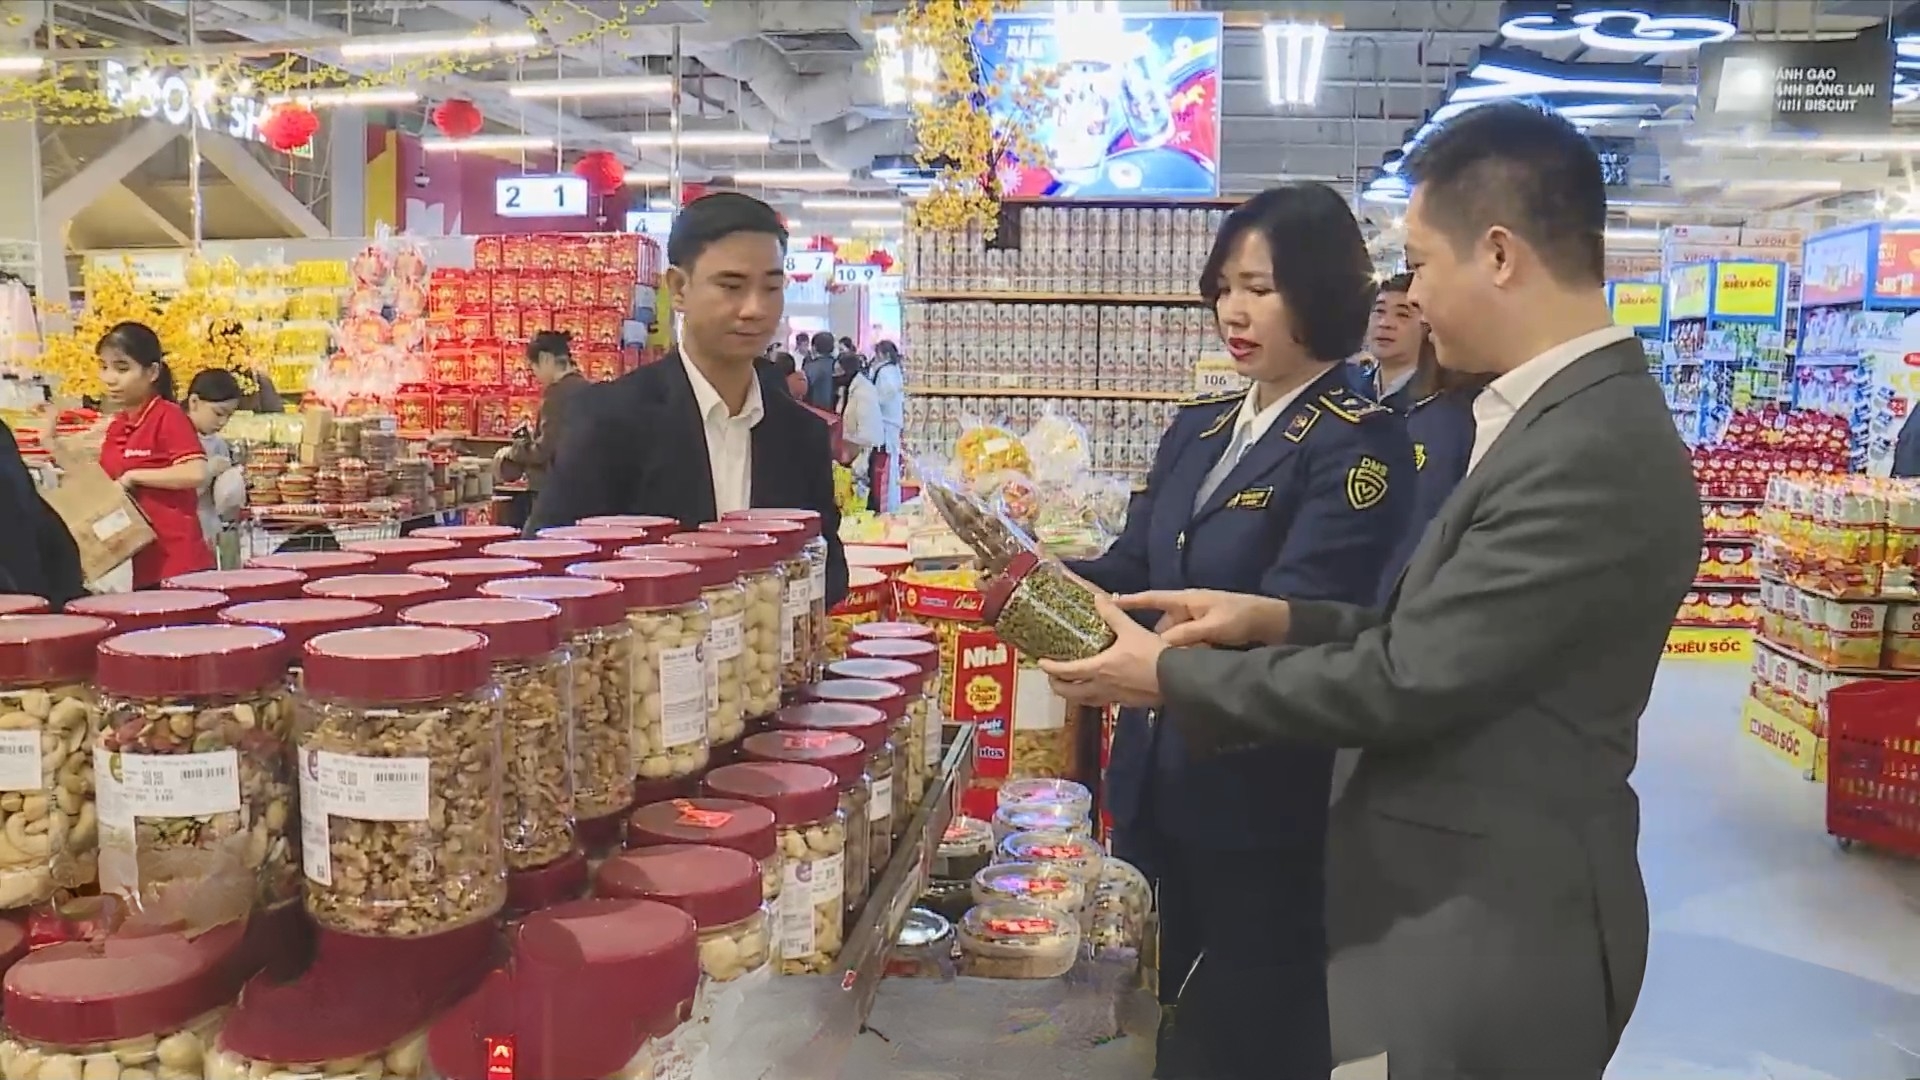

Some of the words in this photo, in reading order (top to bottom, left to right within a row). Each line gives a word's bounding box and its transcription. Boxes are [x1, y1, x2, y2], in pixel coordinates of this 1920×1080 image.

[1773, 66, 1803, 80] ÁNH
[1848, 83, 1875, 96] LAN
[1804, 99, 1858, 112] BISCUIT
[505, 186, 521, 208] 2
[553, 184, 565, 207] 1
[785, 257, 796, 271] 8
[815, 257, 823, 270] 7
[838, 269, 856, 281] 10
[863, 269, 874, 280] 9
[1203, 374, 1227, 386] 106
[1673, 640, 1706, 654] SIÊU
[1709, 636, 1742, 653] SỐC
[1779, 729, 1801, 757] SỐC
